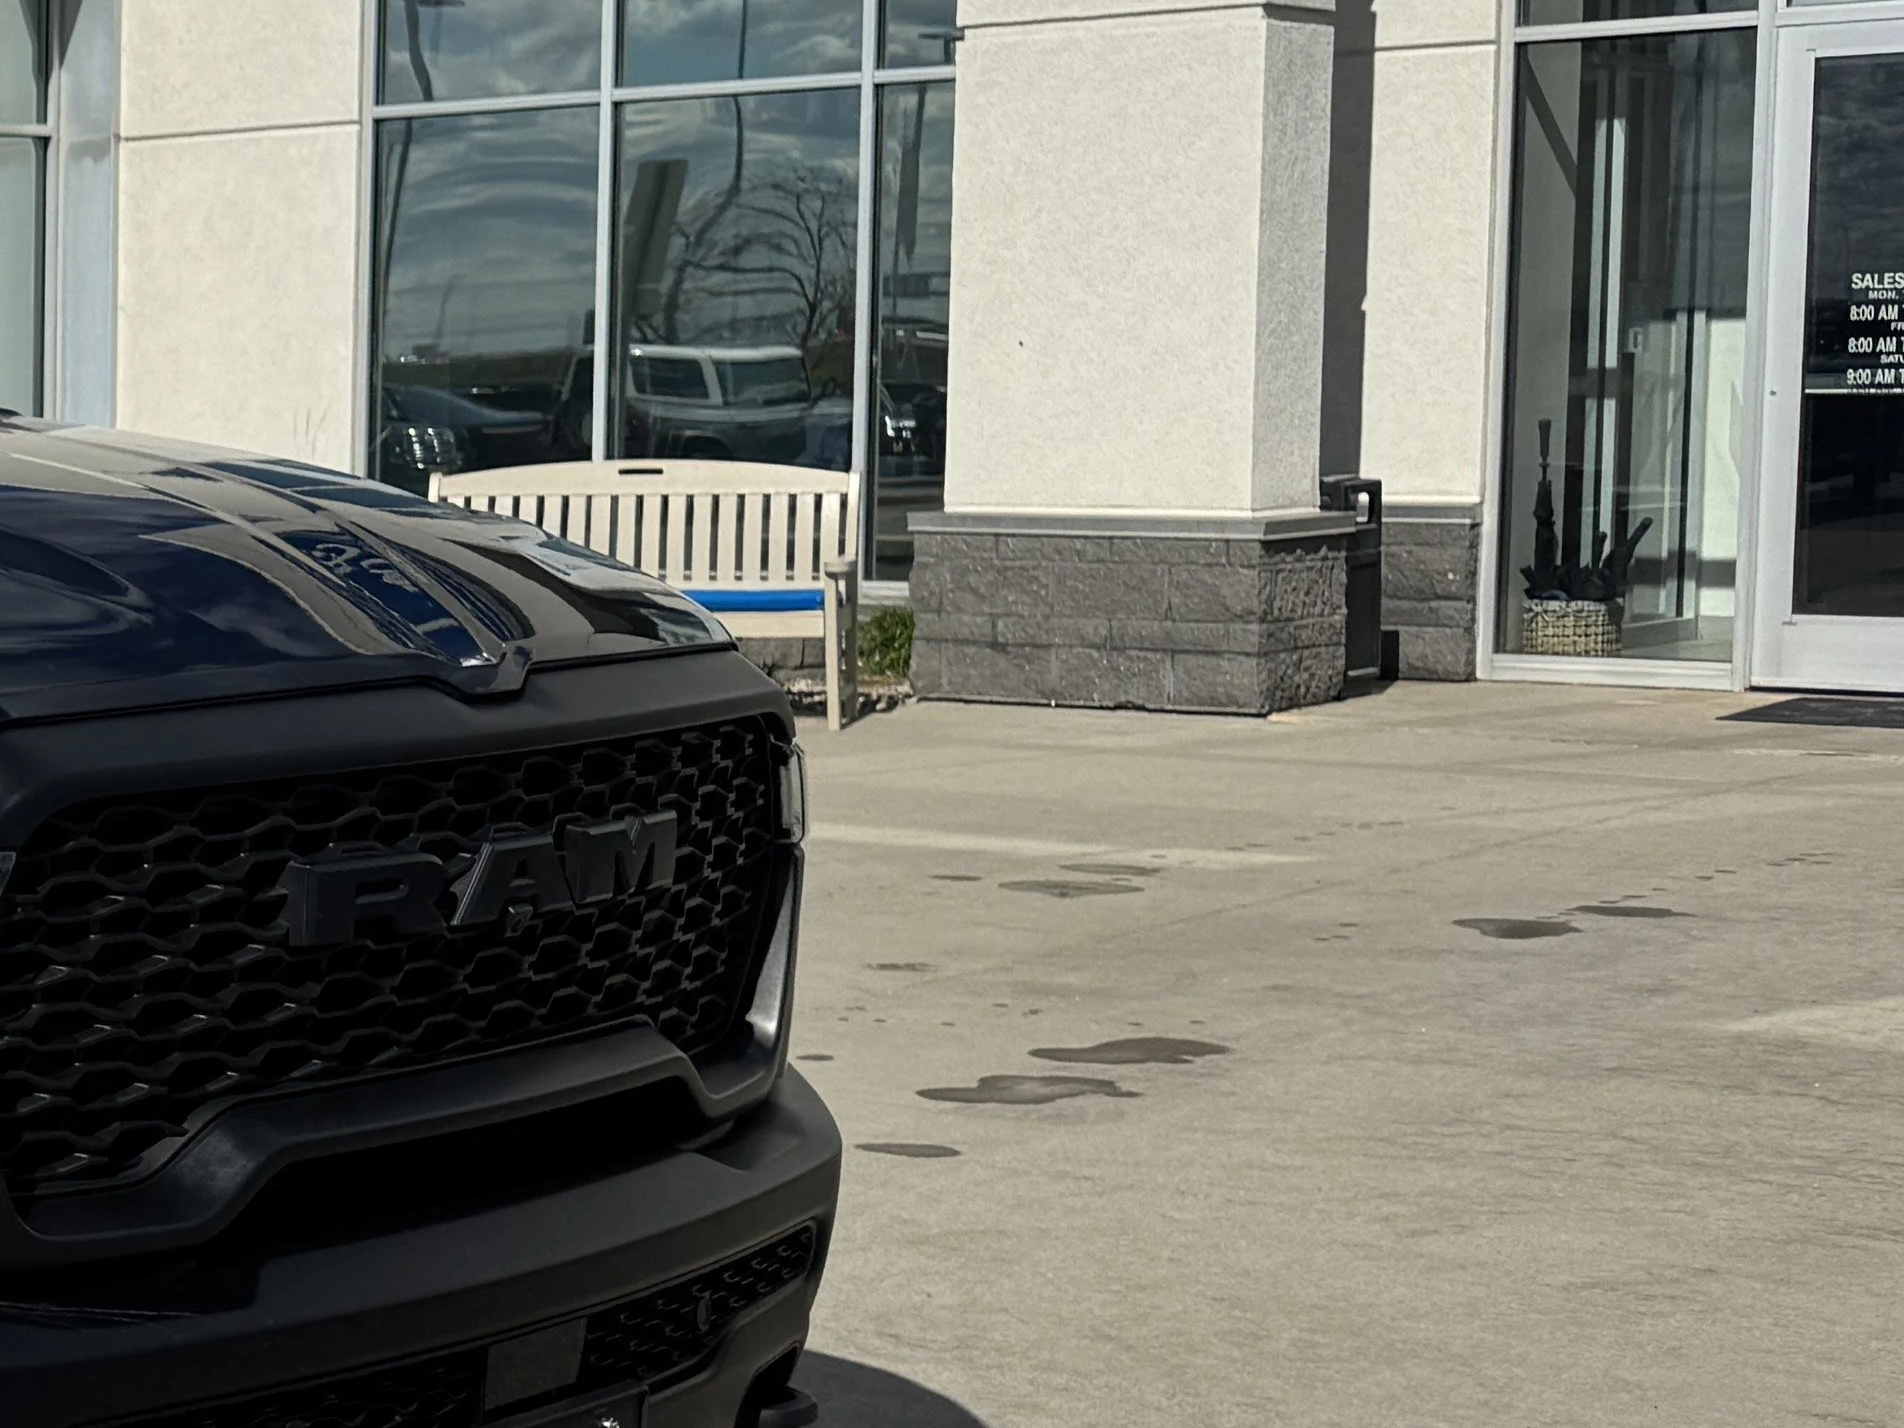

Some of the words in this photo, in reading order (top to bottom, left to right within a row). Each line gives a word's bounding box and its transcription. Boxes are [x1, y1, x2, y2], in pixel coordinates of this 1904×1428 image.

[1851, 272, 1904, 289] SALES
[1850, 304, 1875, 321] 8:00
[1878, 304, 1899, 321] AM
[1848, 336, 1873, 353] 8:00
[1876, 336, 1897, 352] AM
[1847, 368, 1872, 385] 9:00
[1875, 368, 1896, 384] AM
[286, 810, 677, 948] RAM
